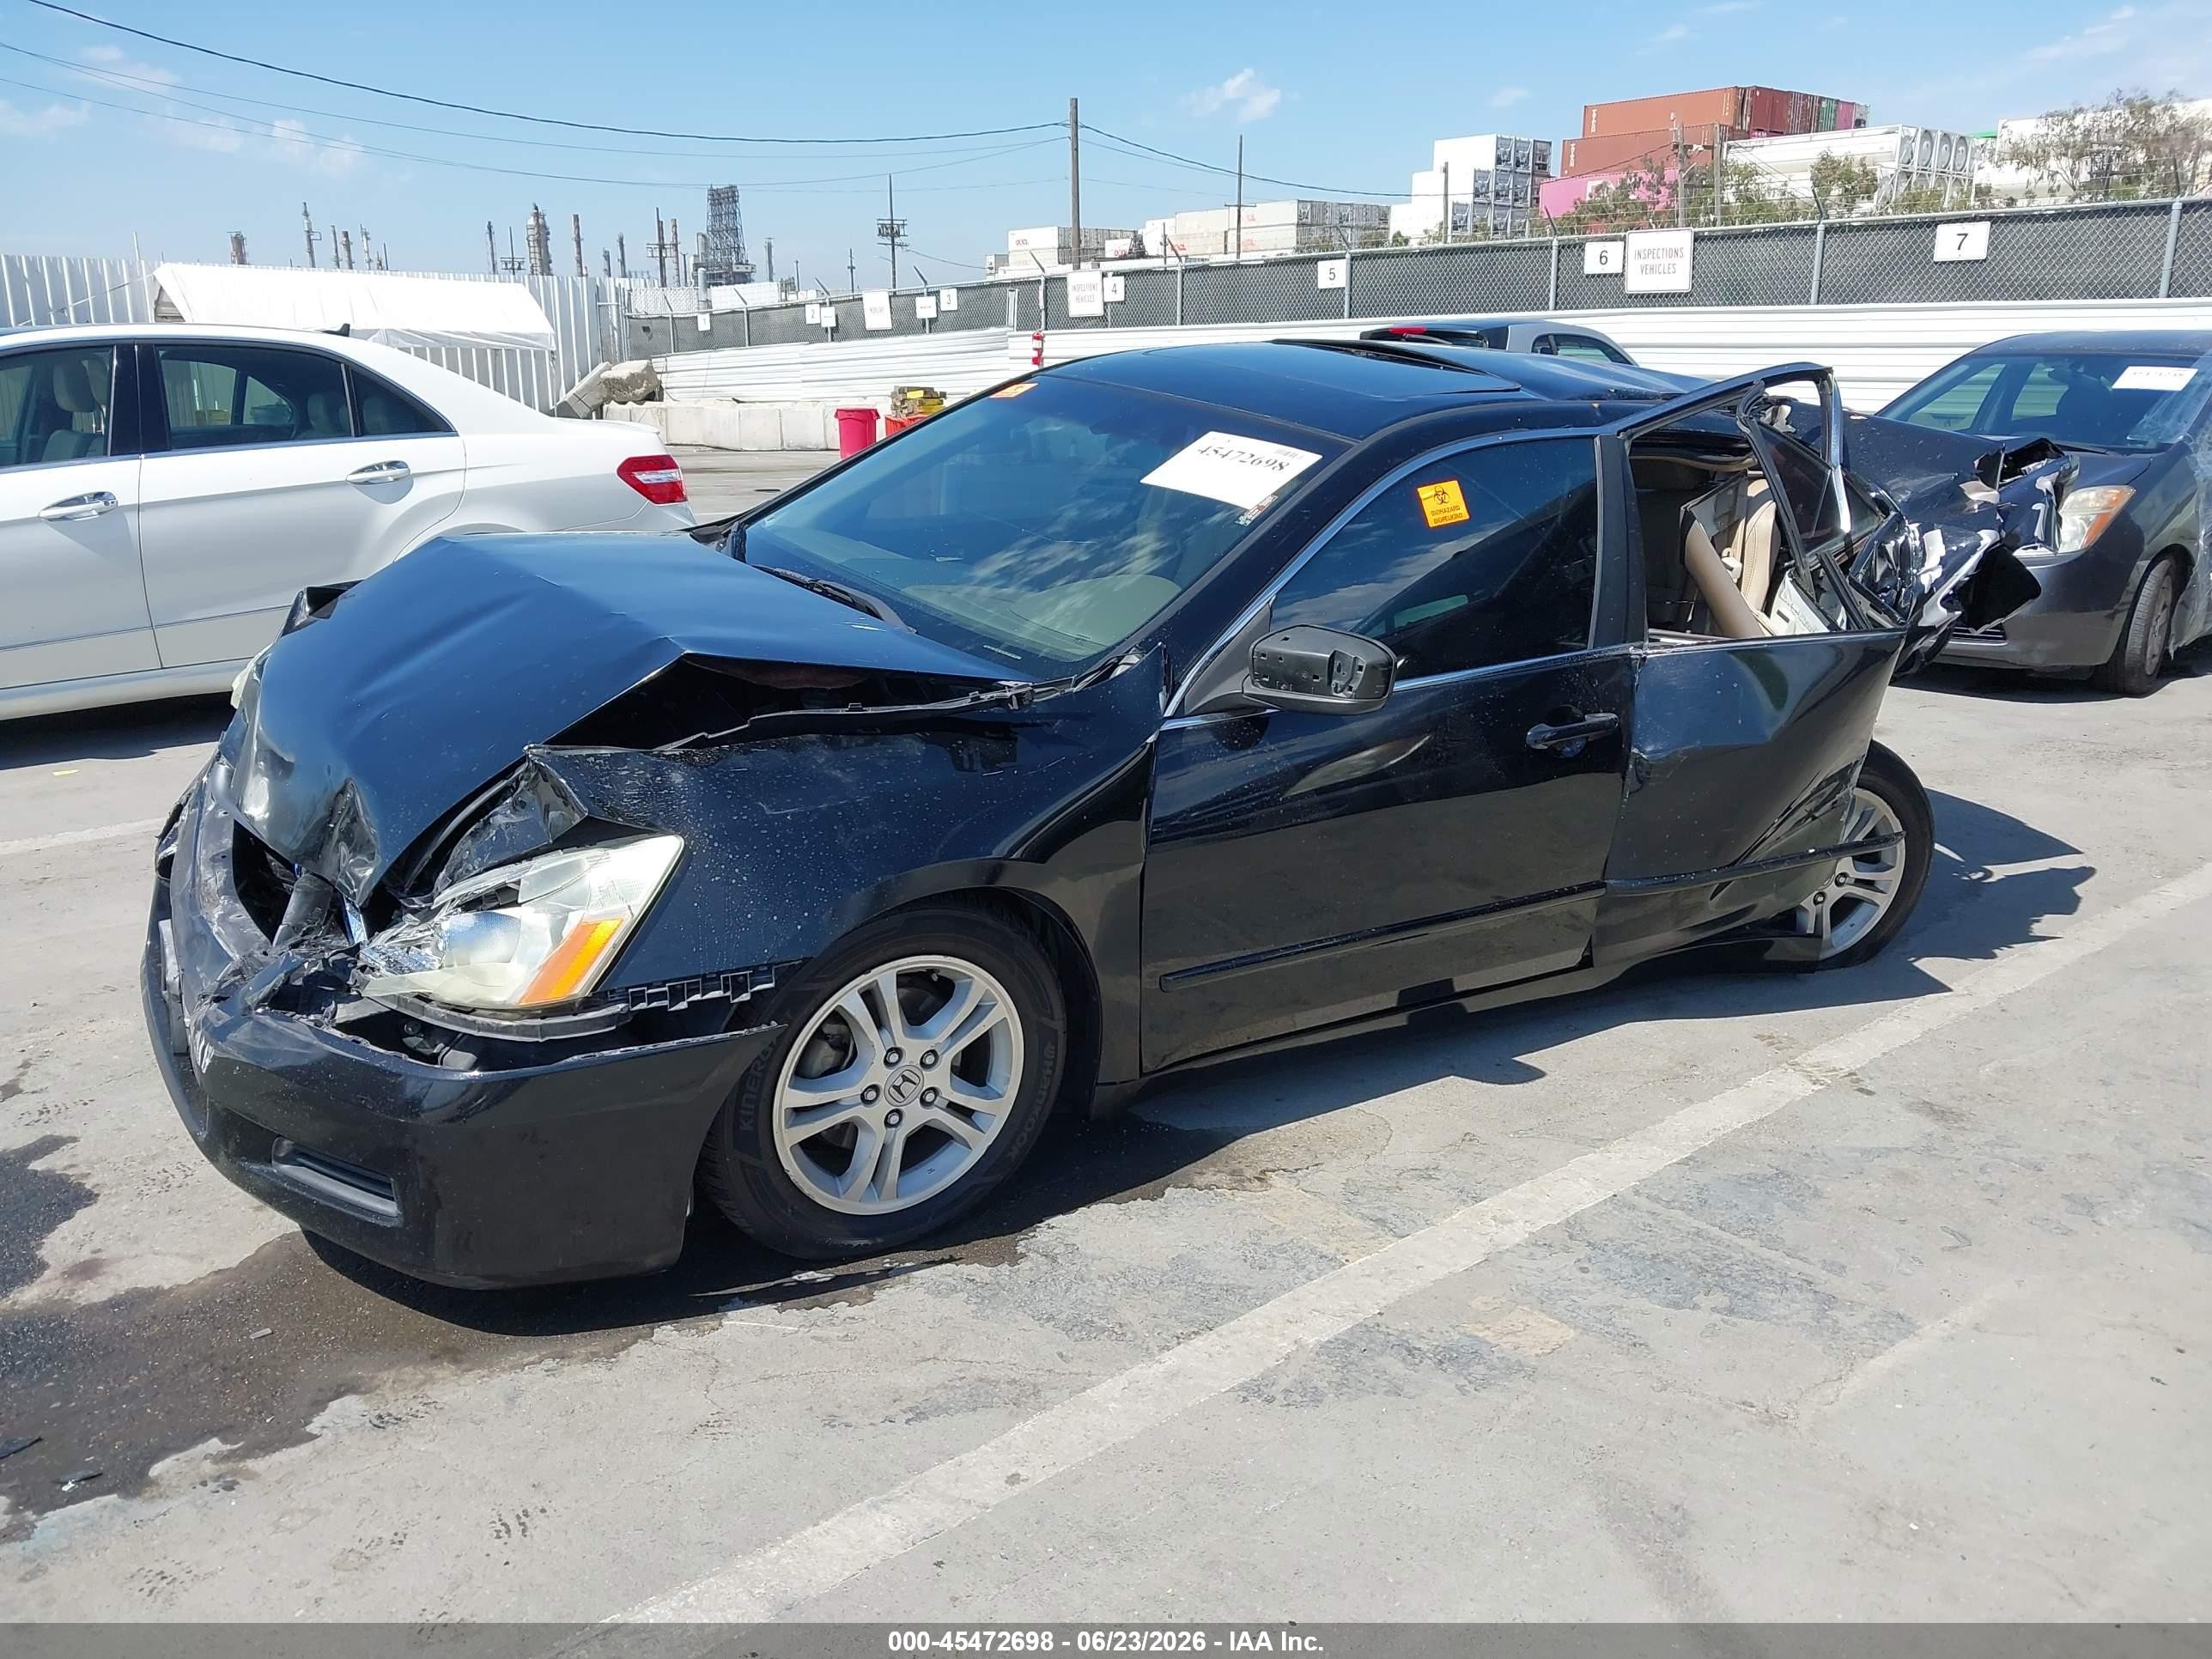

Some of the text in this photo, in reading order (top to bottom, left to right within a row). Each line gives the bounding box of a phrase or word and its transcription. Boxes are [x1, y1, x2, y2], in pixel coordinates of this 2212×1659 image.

[1956, 233, 1969, 251] 7
[1599, 250, 1608, 265] 6
[1634, 246, 1684, 260] INSPECTIONS
[1328, 267, 1336, 281] 5
[1640, 263, 1677, 275] VEHICLES
[1111, 283, 1117, 295] 4
[946, 294, 951, 305] 3
[811, 309, 816, 319] 2
[1197, 446, 1290, 471] 45472698
